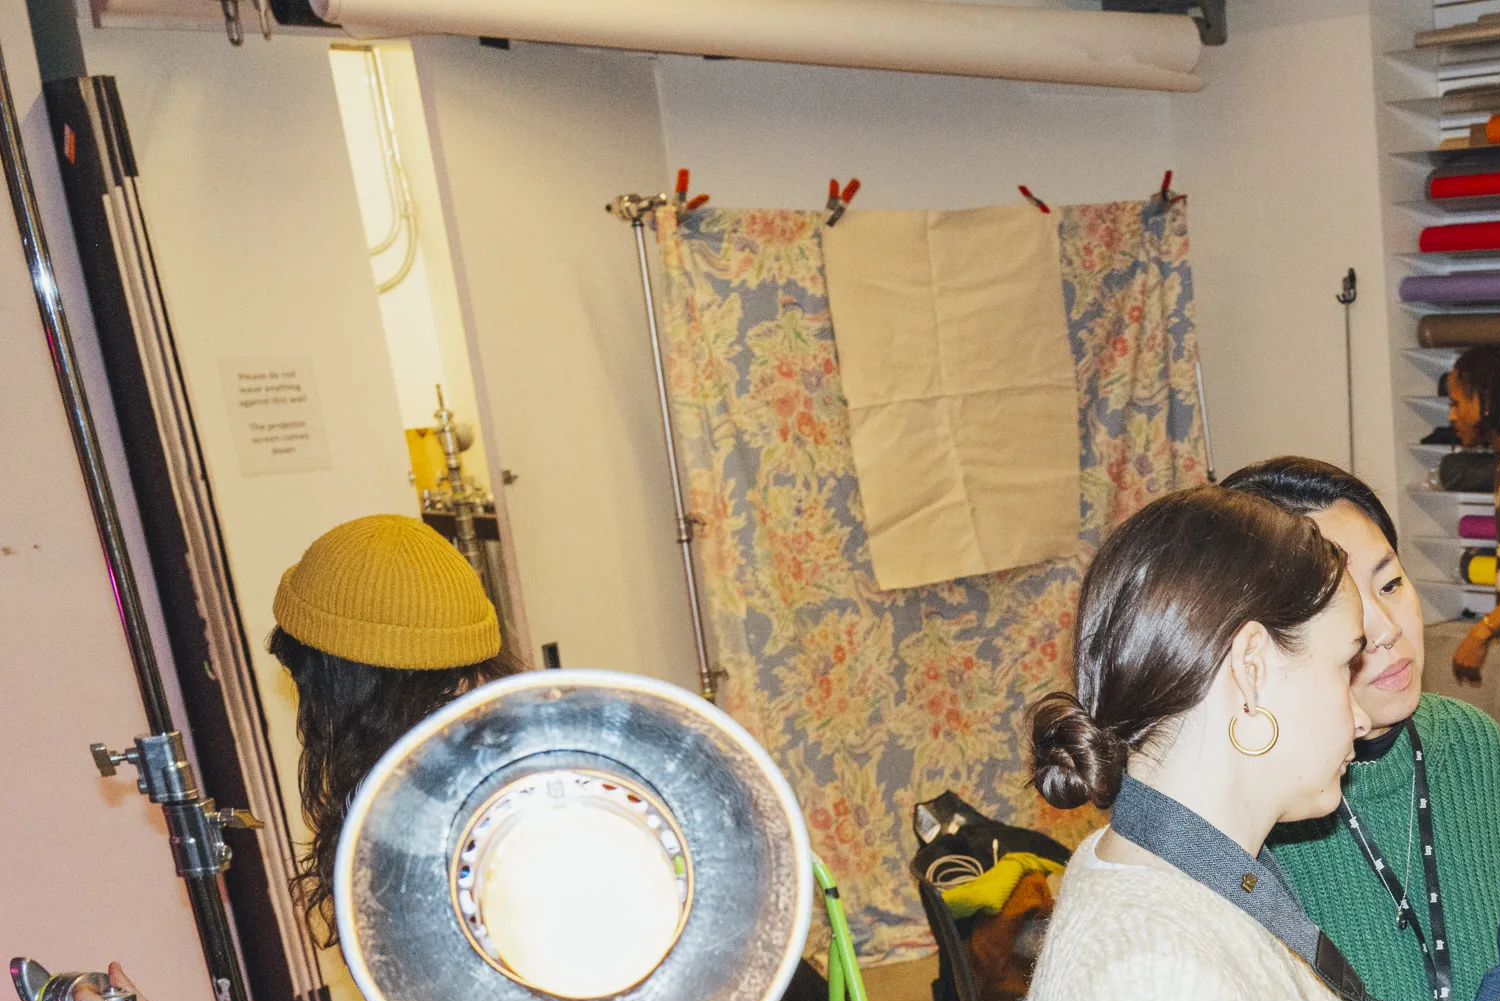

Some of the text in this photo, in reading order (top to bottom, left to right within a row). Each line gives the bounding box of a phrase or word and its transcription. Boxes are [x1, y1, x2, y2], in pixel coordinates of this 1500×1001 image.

[264, 384, 301, 393] anything
[240, 398, 269, 408] against
[271, 396, 287, 404] this
[249, 420, 306, 431] The projector
